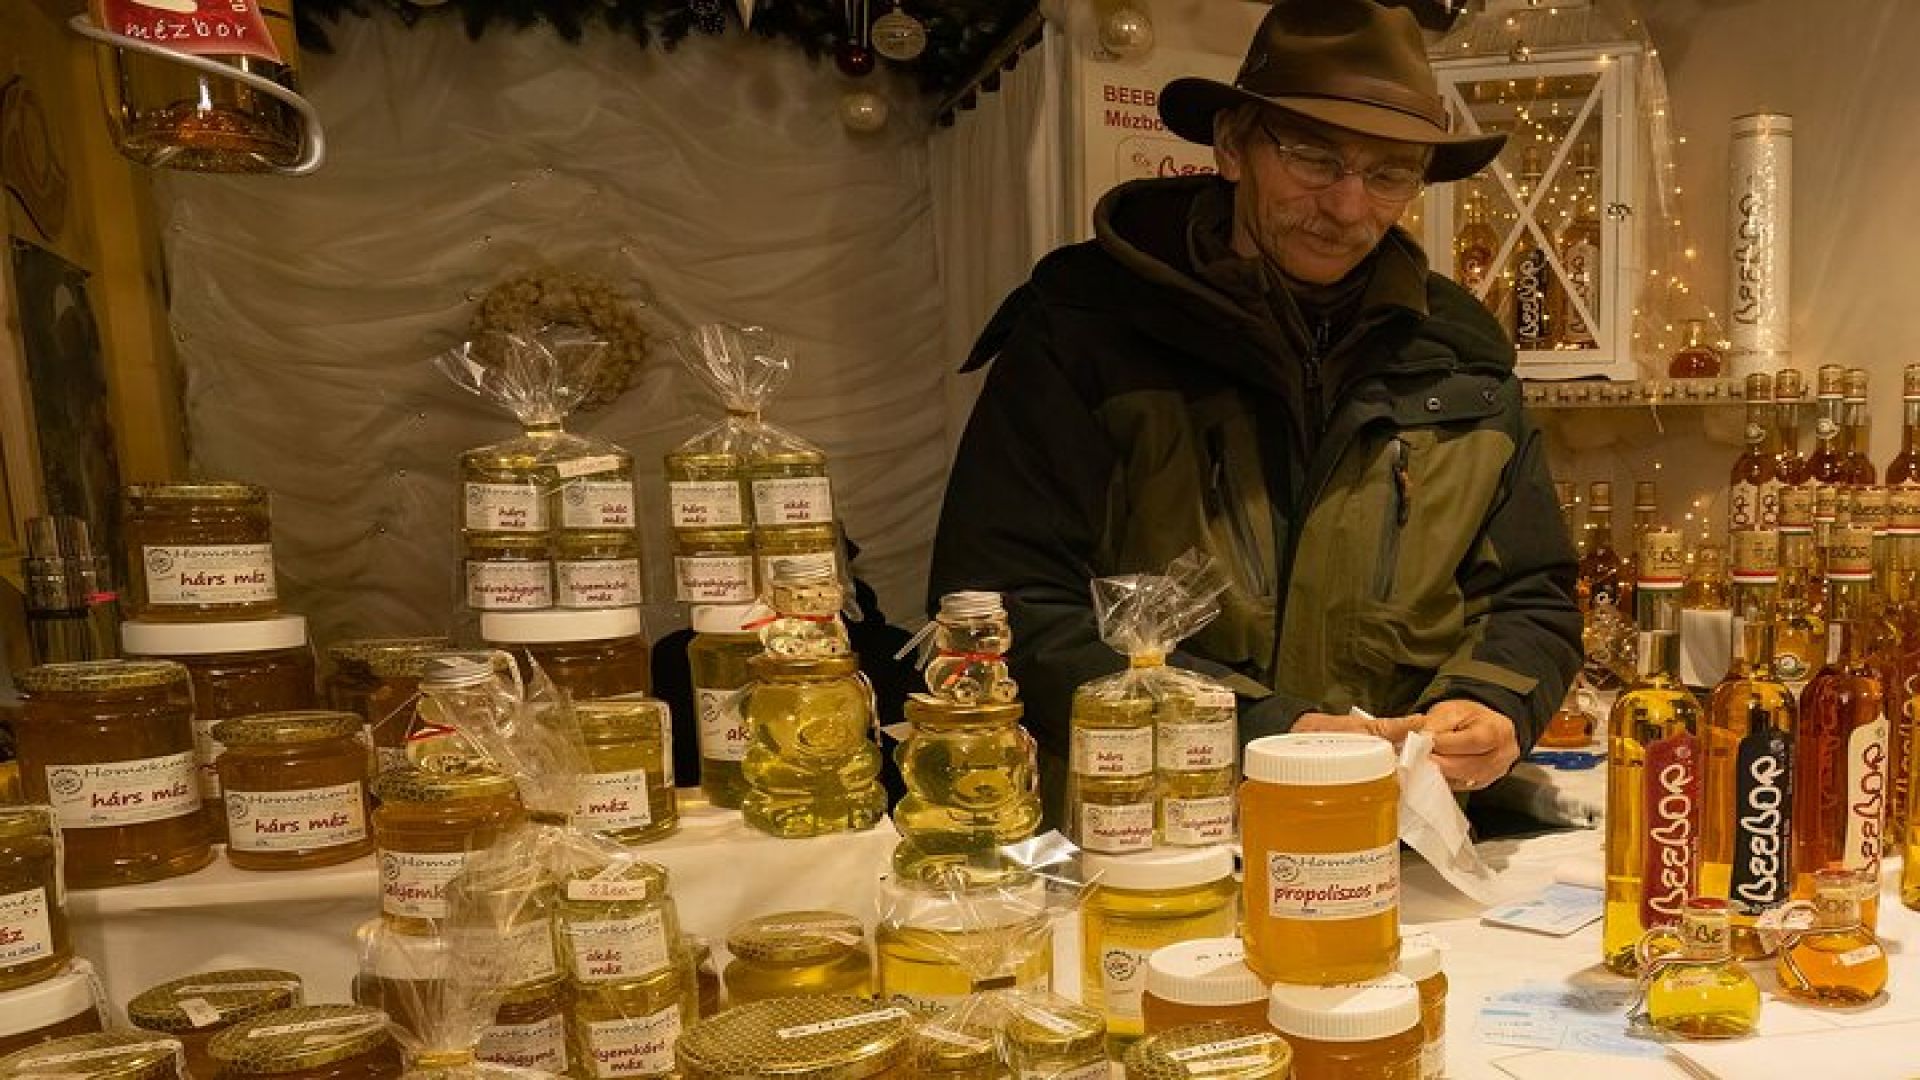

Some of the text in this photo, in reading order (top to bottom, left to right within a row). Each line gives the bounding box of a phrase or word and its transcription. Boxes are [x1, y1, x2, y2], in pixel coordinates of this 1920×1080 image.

[125, 17, 247, 40] mézbor
[180, 568, 267, 586] hárs méz
[91, 779, 188, 809] hárs méz
[588, 796, 631, 813] méz
[255, 810, 350, 834] hárs méz
[1273, 883, 1372, 908] propoliszos
